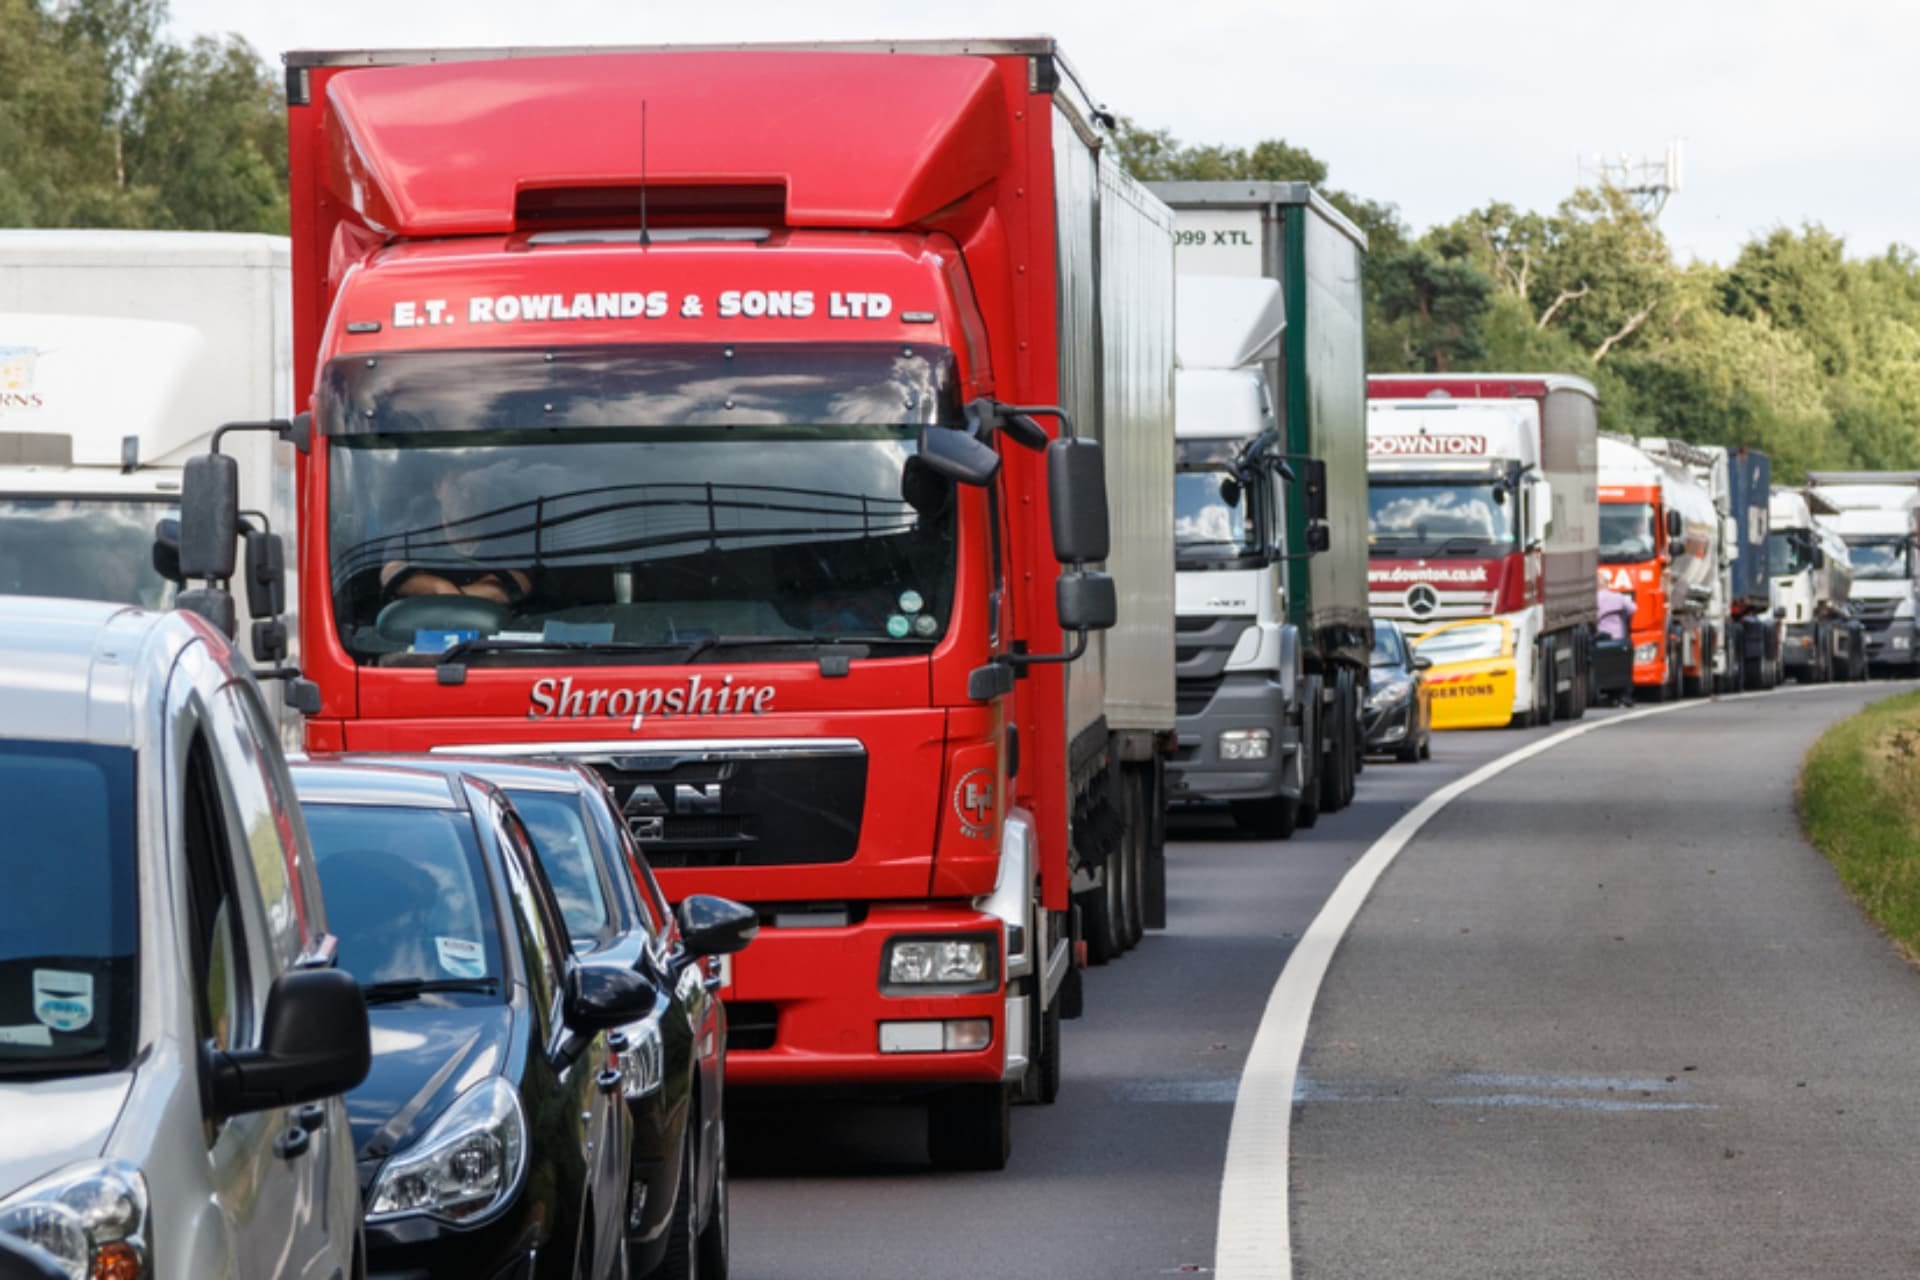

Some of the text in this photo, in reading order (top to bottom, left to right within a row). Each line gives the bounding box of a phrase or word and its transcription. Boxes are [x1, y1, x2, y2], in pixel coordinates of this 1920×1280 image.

[1213, 230, 1253, 246] XTL
[393, 290, 893, 327] E.T. ROWLANDS & SONS LTD
[528, 673, 776, 731] Shropshire
[607, 784, 721, 814] AN
